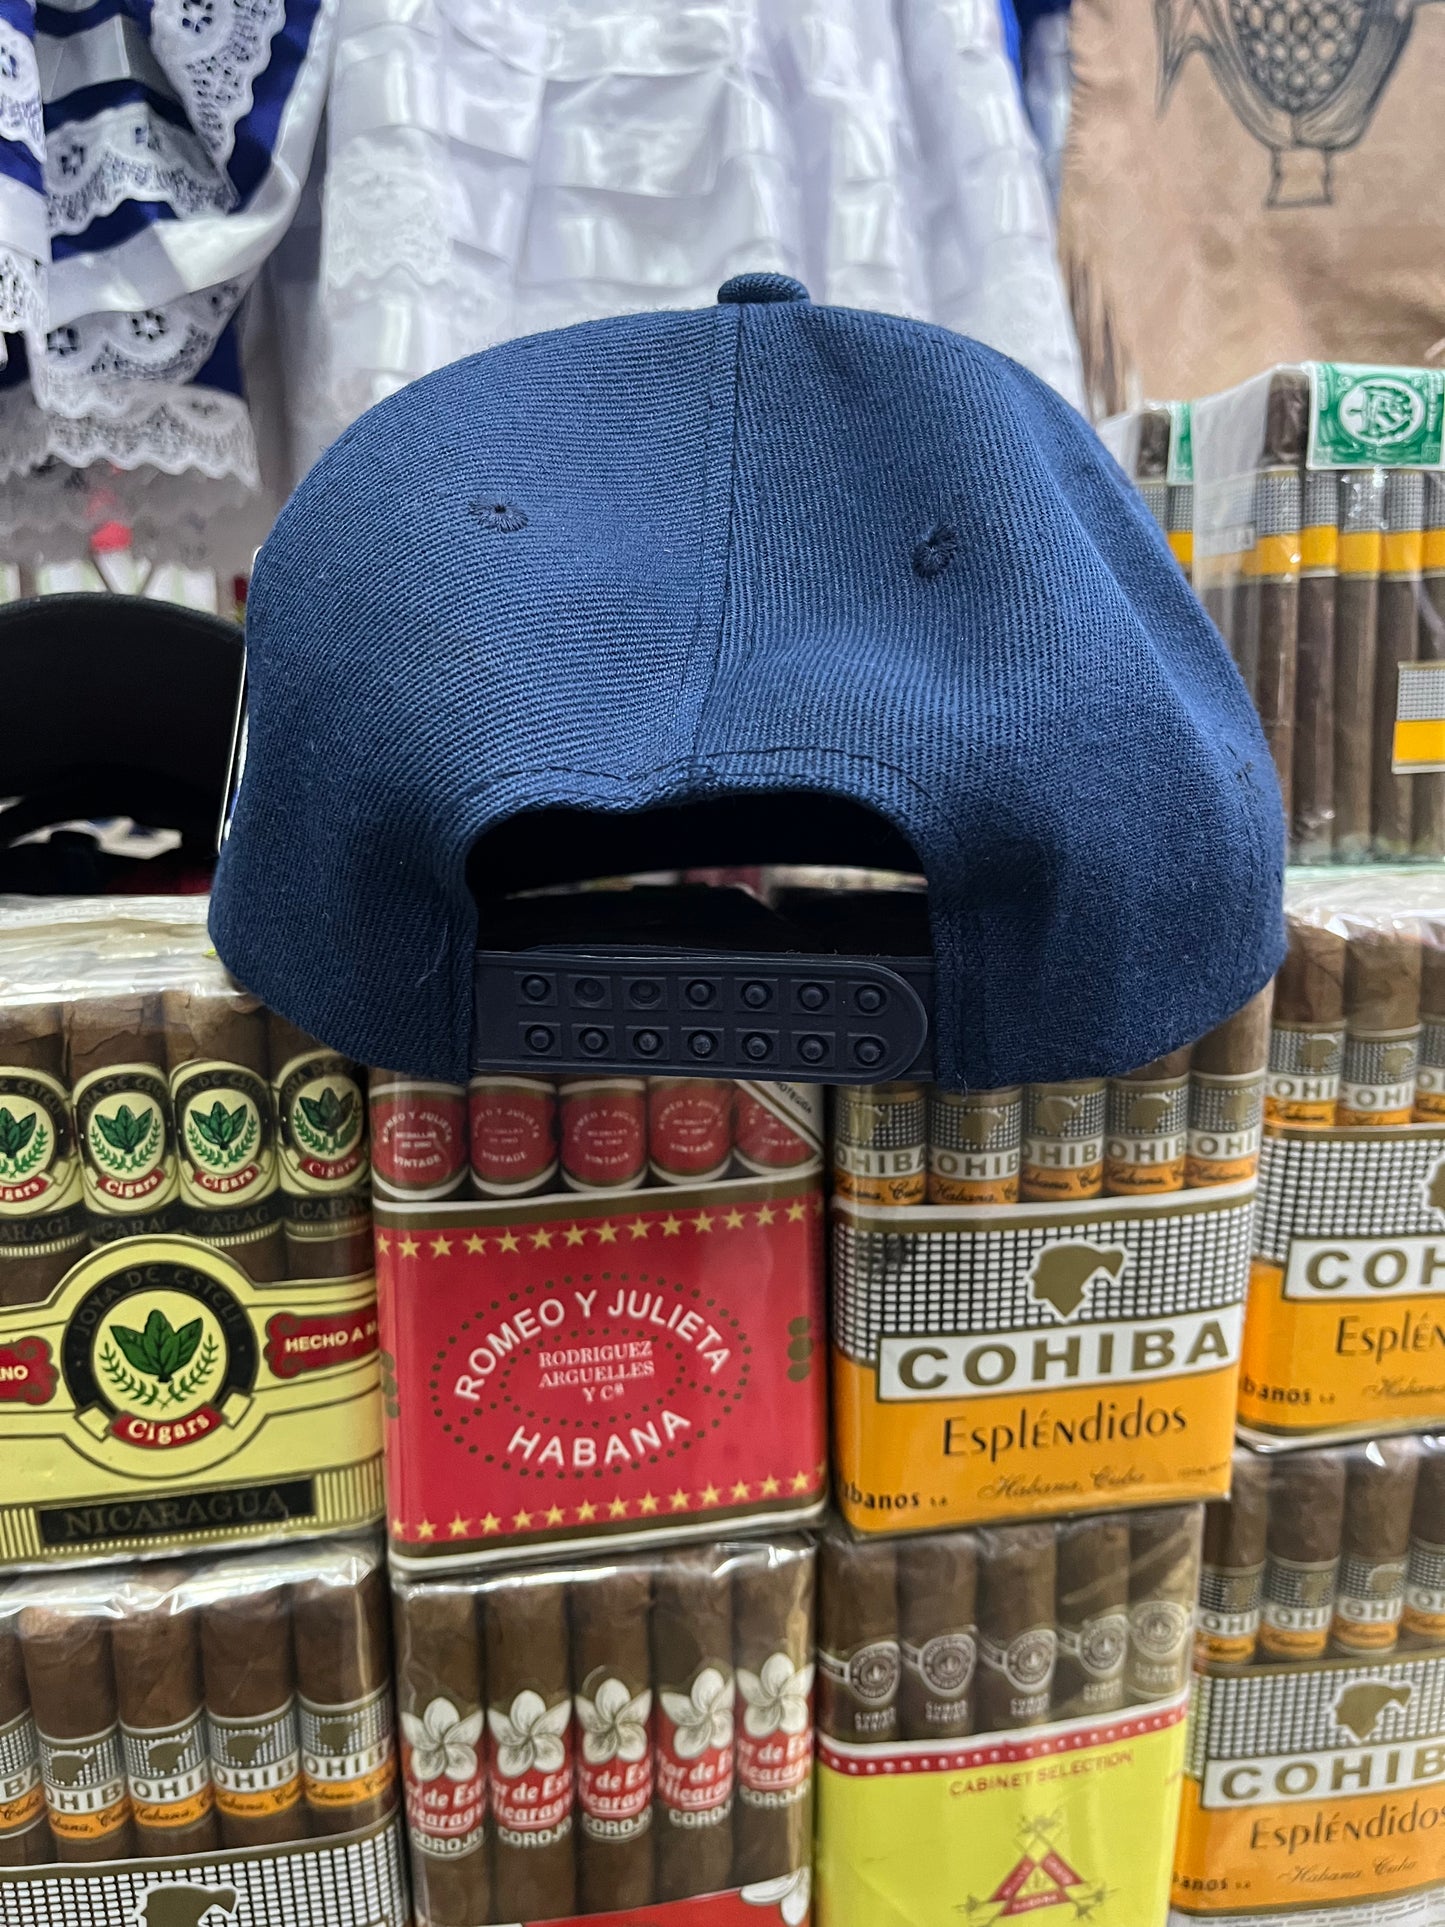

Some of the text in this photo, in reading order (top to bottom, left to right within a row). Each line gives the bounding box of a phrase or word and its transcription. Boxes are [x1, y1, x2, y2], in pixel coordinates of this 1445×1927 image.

[382, 1111, 407, 1144] ROMEO
[419, 1111, 453, 1143] JULIETA
[308, 1157, 357, 1178] Cigars
[393, 1153, 443, 1168] VINTAGE
[105, 1175, 158, 1198] Cigars
[202, 1170, 253, 1192] Cigars
[74, 1286, 119, 1336] JOYA
[284, 1328, 349, 1354] HECHO
[350, 1325, 365, 1344] A
[454, 1288, 731, 1401] ROMEO Y JULIETA
[538, 1340, 654, 1369] RODRIGUEZ
[897, 1319, 1231, 1391] COHIBA
[538, 1360, 656, 1388] ARGUELLES
[582, 1386, 596, 1405] Y
[128, 1413, 211, 1445] Cigars
[507, 1409, 691, 1468] HABANA
[63, 1489, 286, 1537] NICARAGUA
[757, 1743, 783, 1765] de
[595, 1770, 622, 1793] de
[689, 1761, 716, 1785] de
[948, 1770, 1033, 1798] CABINET
[1036, 1749, 1135, 1781] SELECTION
[424, 1788, 449, 1809] de
[511, 1782, 539, 1804] de
